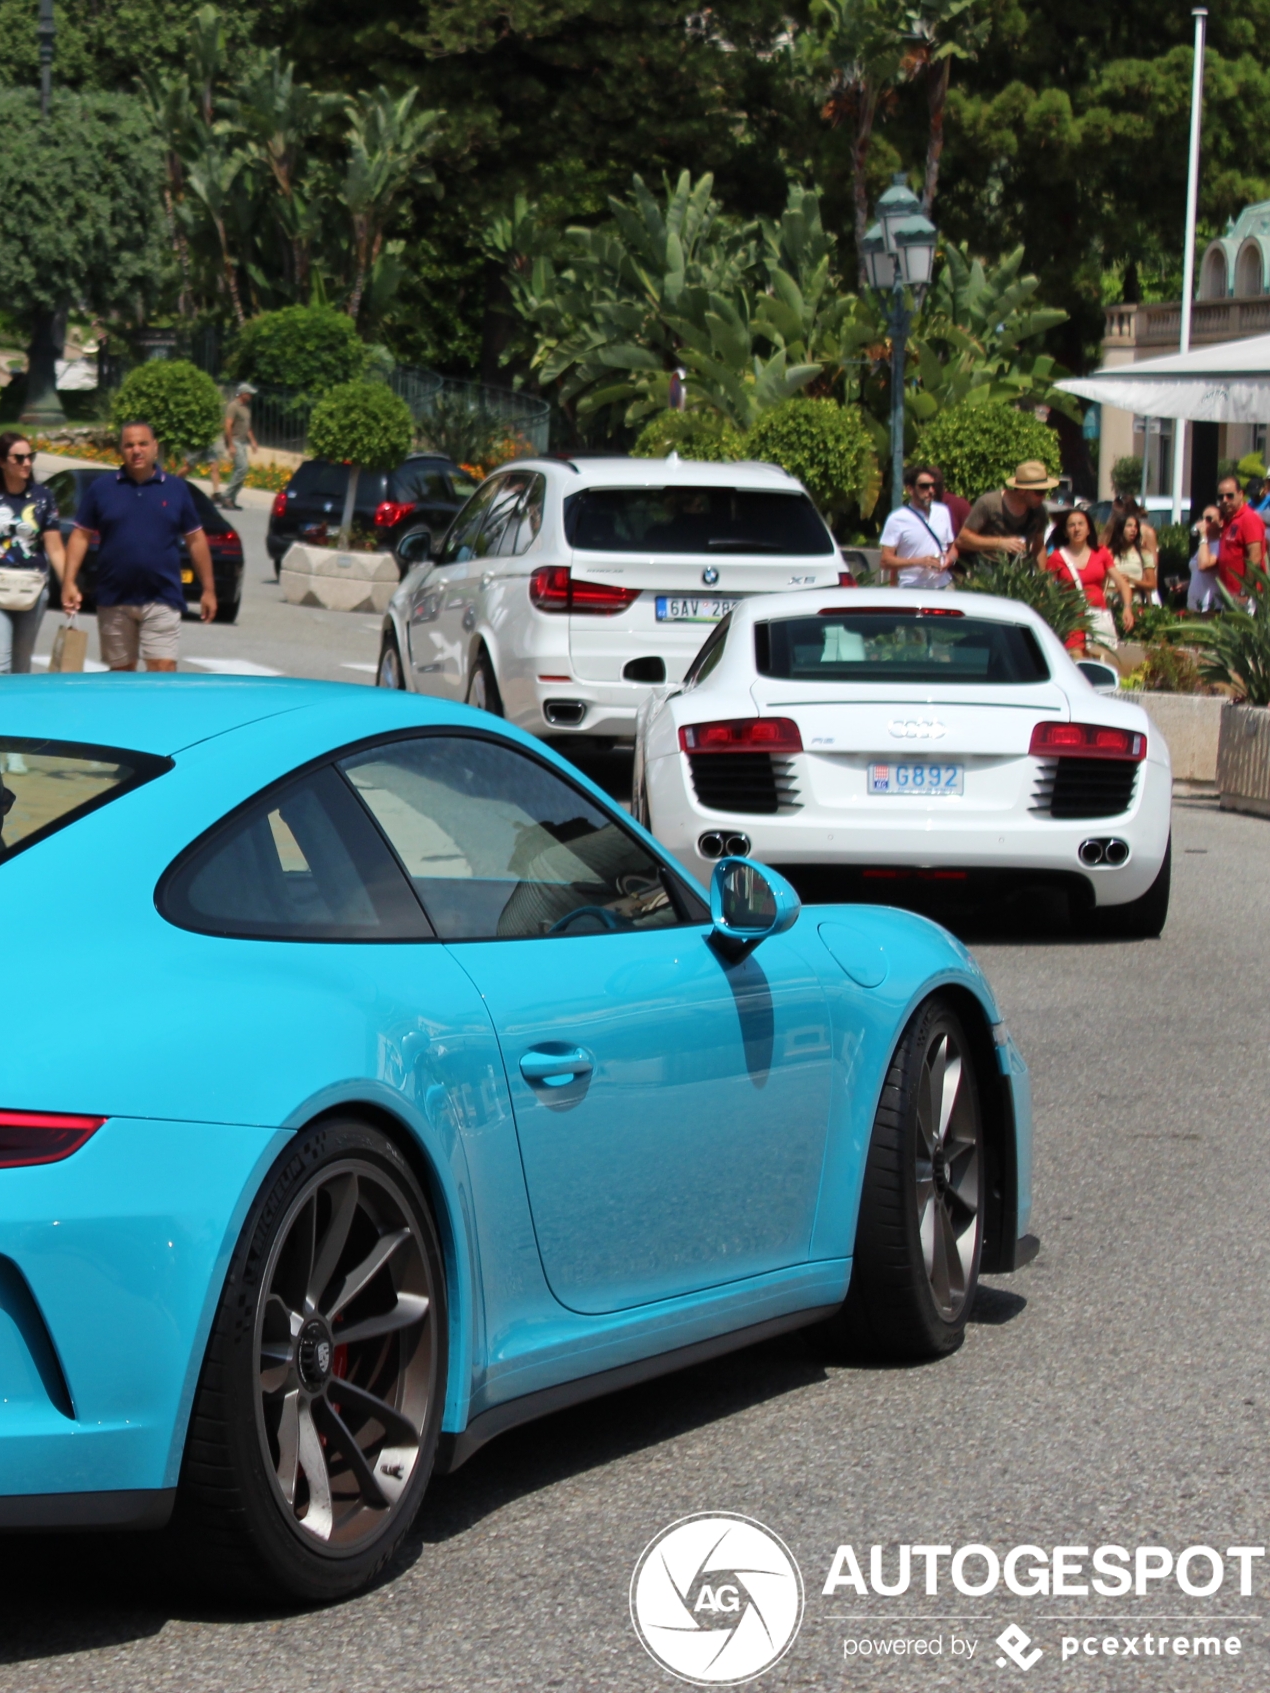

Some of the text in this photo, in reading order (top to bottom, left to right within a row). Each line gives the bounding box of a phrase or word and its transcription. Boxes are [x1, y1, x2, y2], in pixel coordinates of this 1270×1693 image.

[788, 575, 817, 586] X5
[670, 600, 699, 617] 6AV
[896, 764, 958, 787] G892
[252, 1153, 303, 1257] MICHELIN
